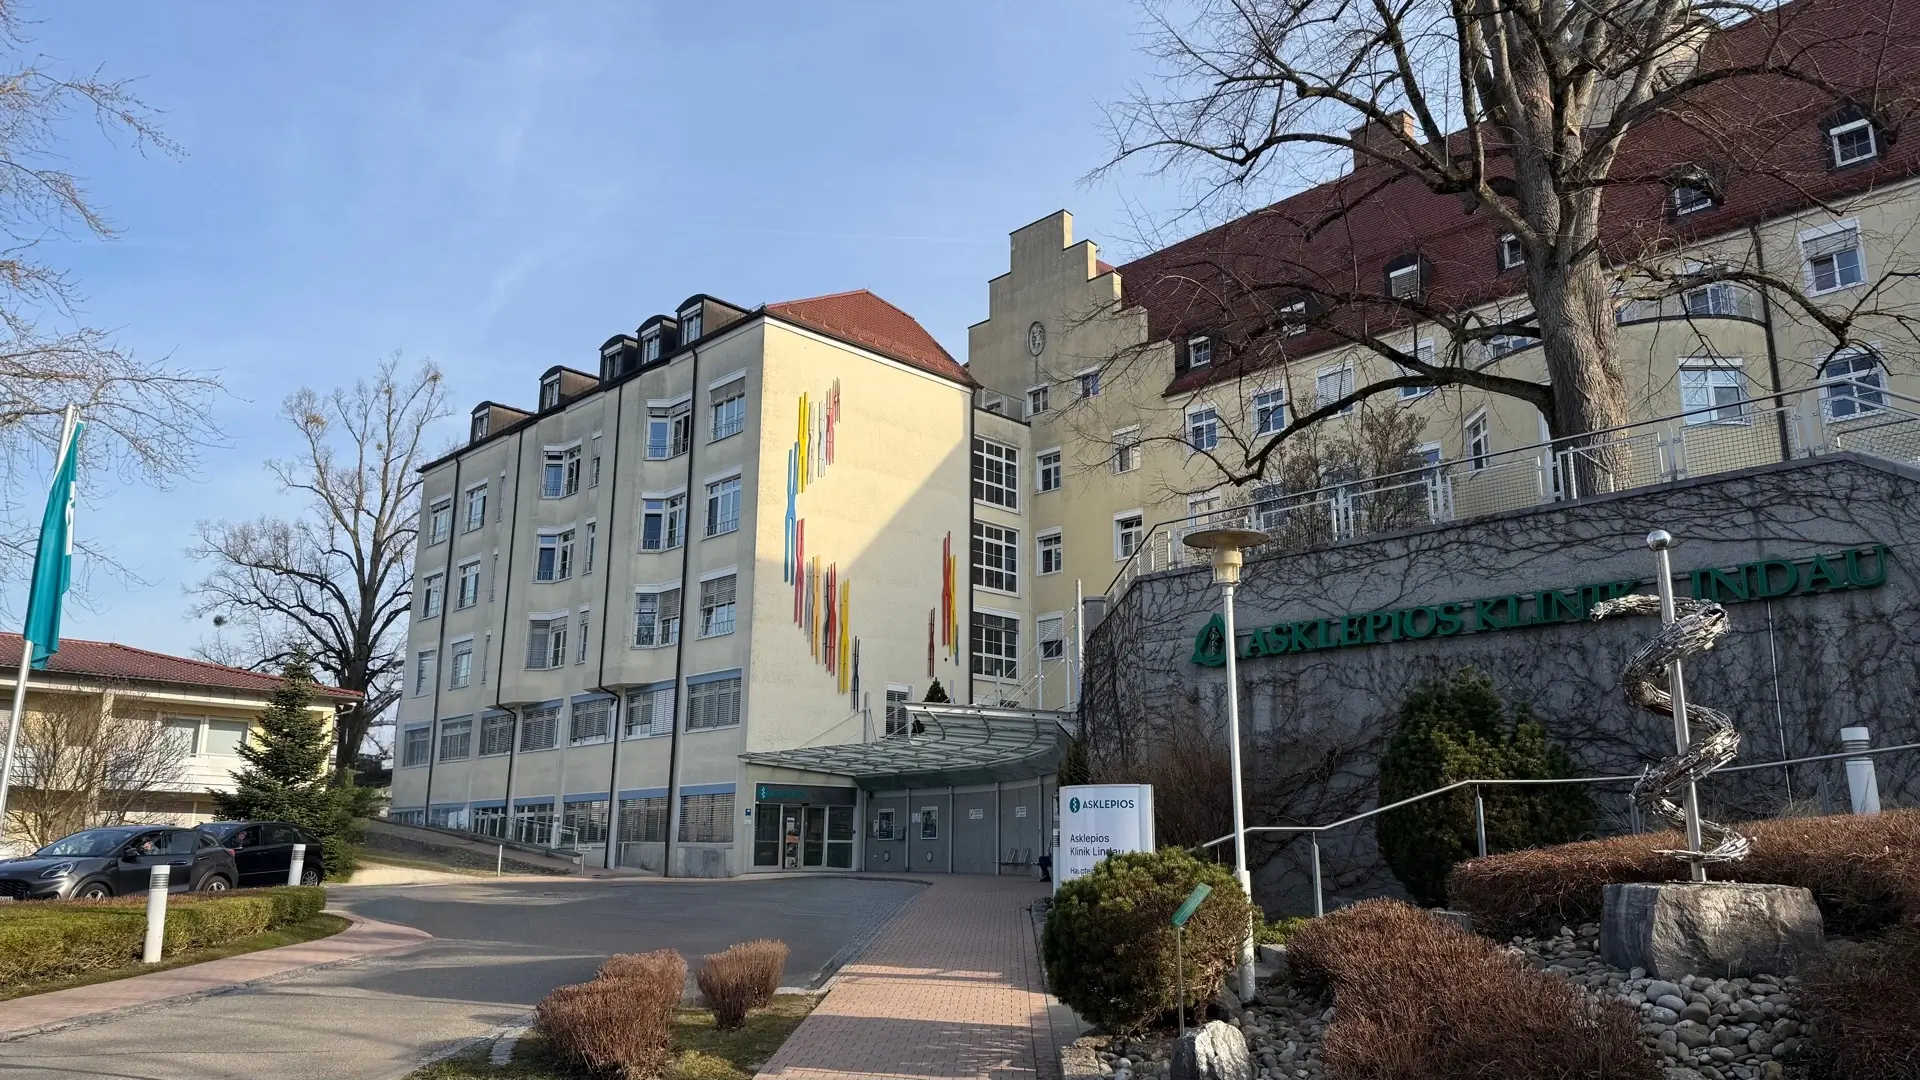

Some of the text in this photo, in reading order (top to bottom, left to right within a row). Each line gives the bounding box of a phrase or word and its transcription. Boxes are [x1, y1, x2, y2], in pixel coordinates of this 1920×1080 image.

[1245, 602, 1464, 657] ASKLEPIOS
[1688, 544, 1889, 605] INDAU
[1082, 799, 1134, 809] ASKLEPIOS
[1070, 833, 1110, 844] Asklepios
[1070, 846, 1090, 857] Klinik
[1070, 867, 1093, 876] Haupte
